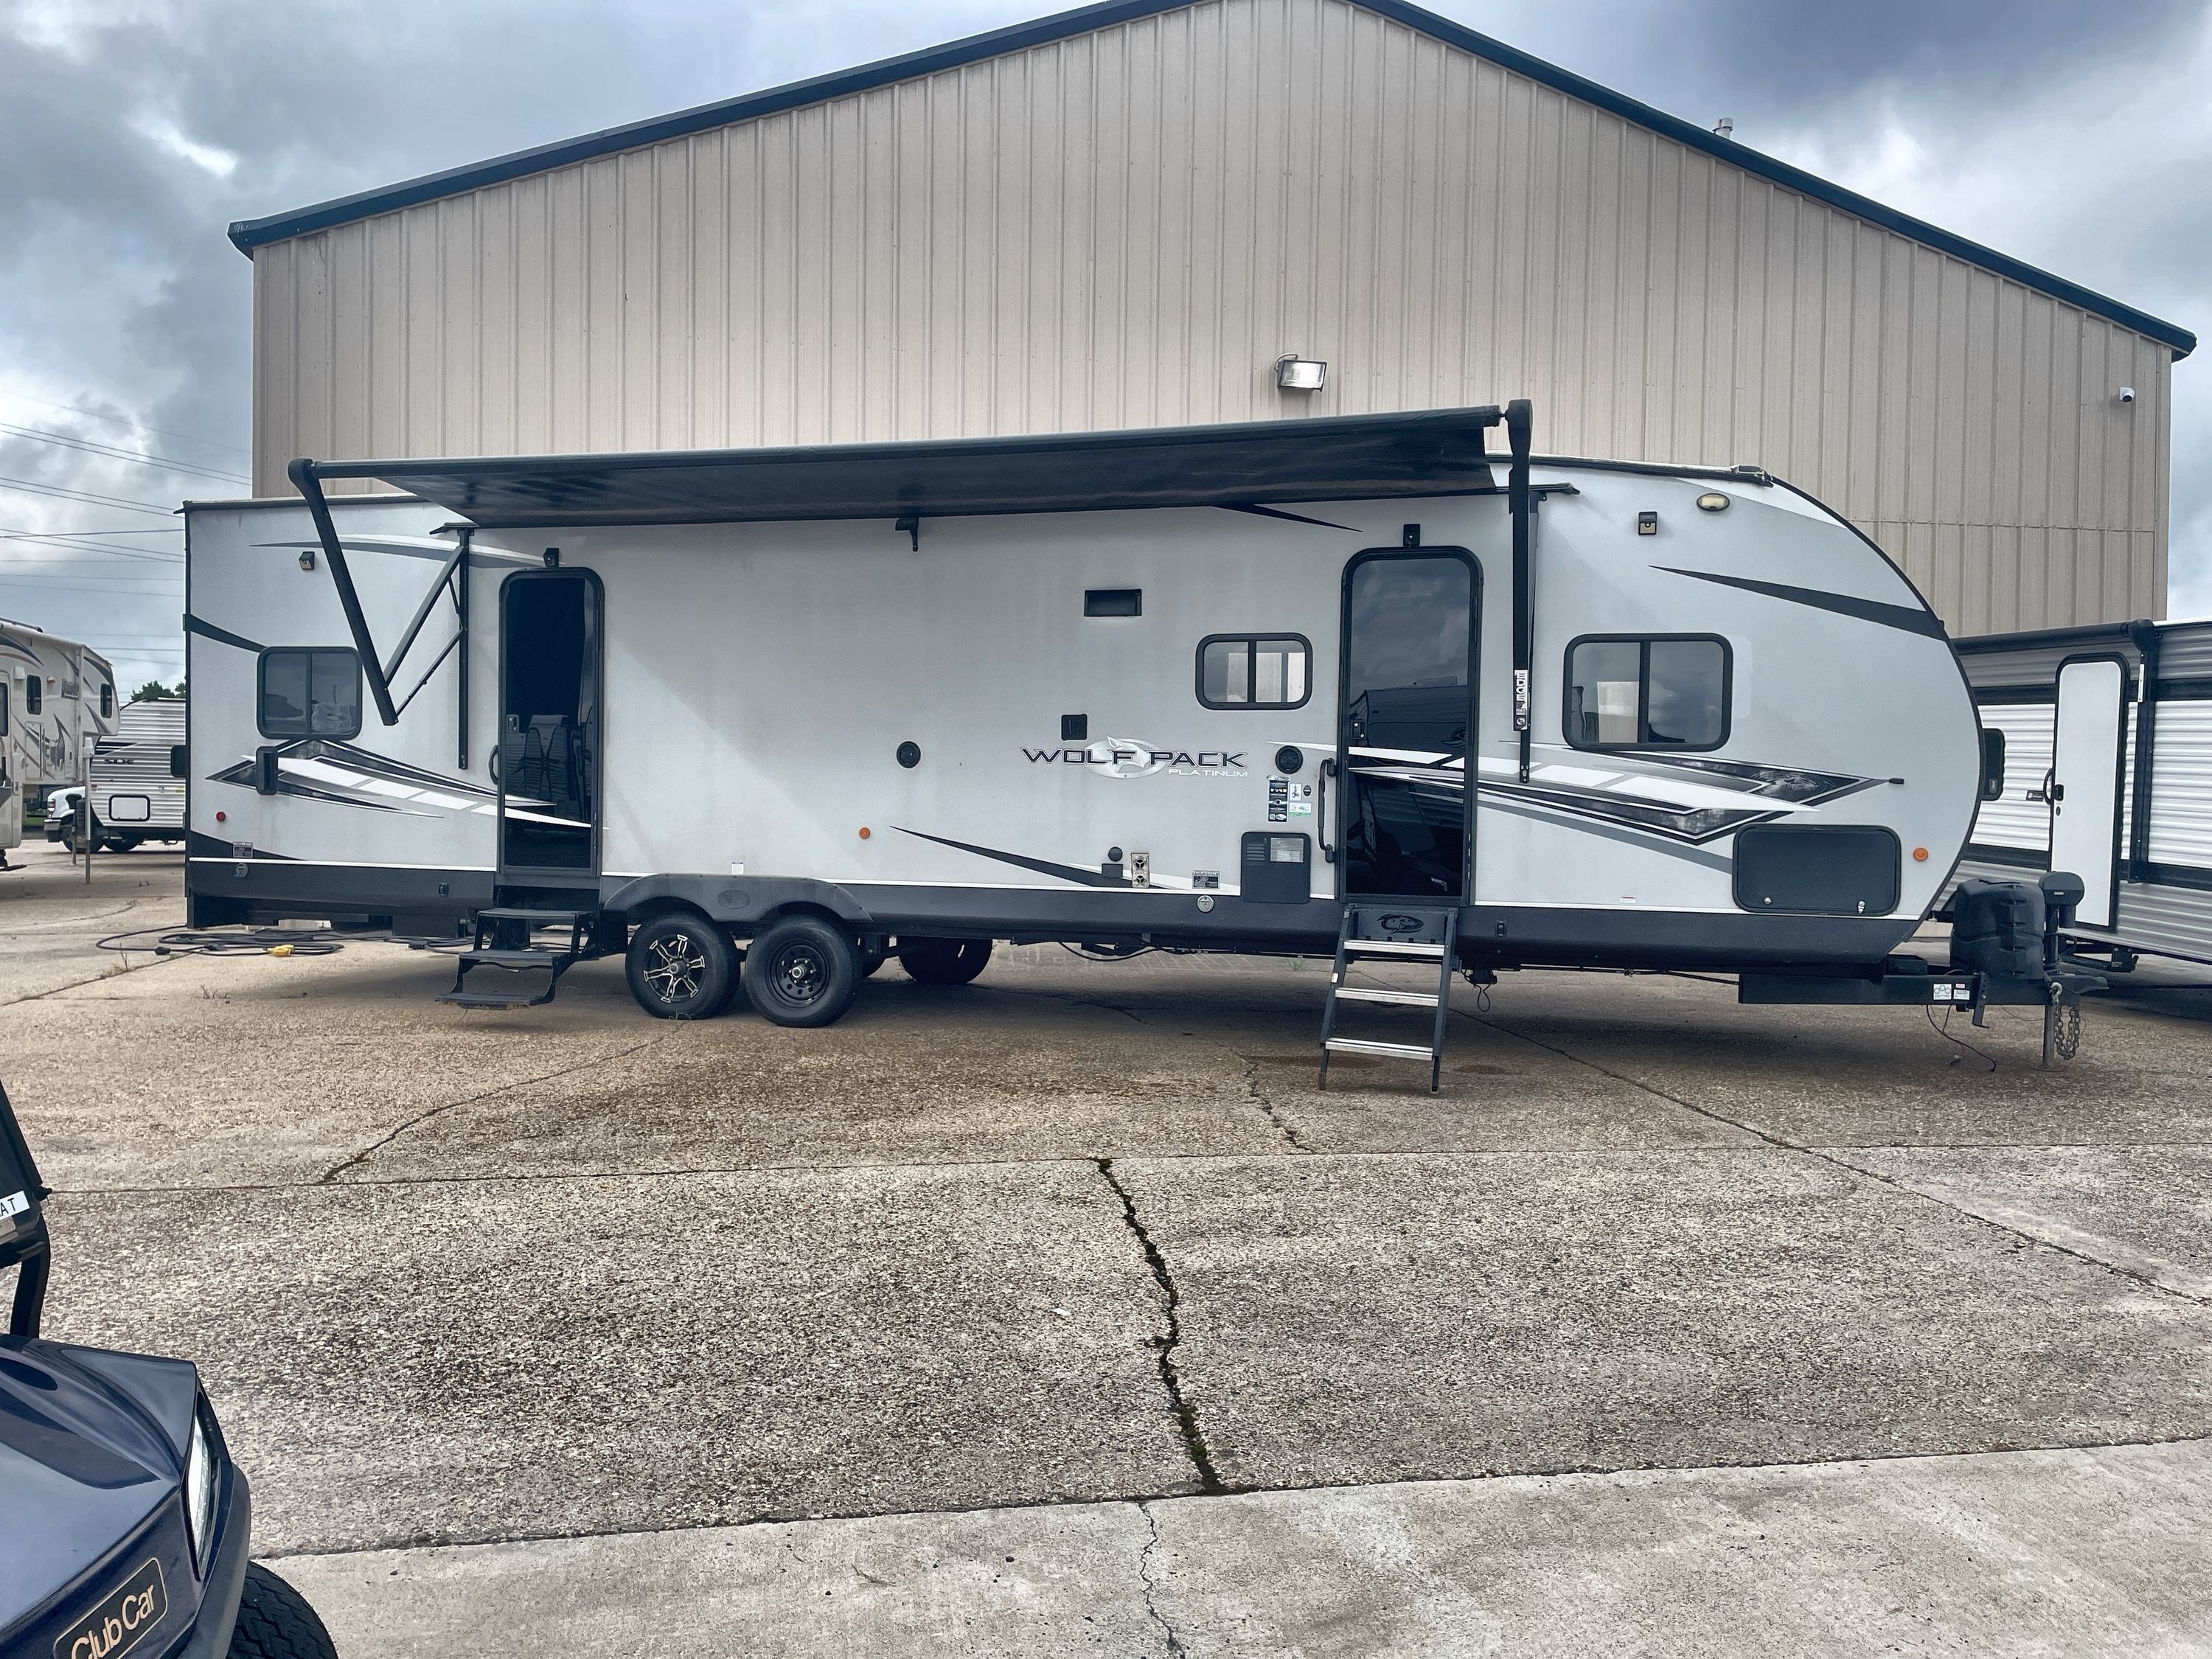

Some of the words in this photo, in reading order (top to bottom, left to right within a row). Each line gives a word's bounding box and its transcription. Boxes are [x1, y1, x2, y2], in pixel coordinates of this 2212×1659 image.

[1516, 671, 1526, 701] EDGE
[1020, 748, 1136, 765] WOLF
[1149, 750, 1248, 768] PACK
[1168, 768, 1248, 777] PLATINUM
[0, 1197, 15, 1217] AT
[71, 1616, 122, 1659] Club
[122, 1585, 154, 1630] Car
